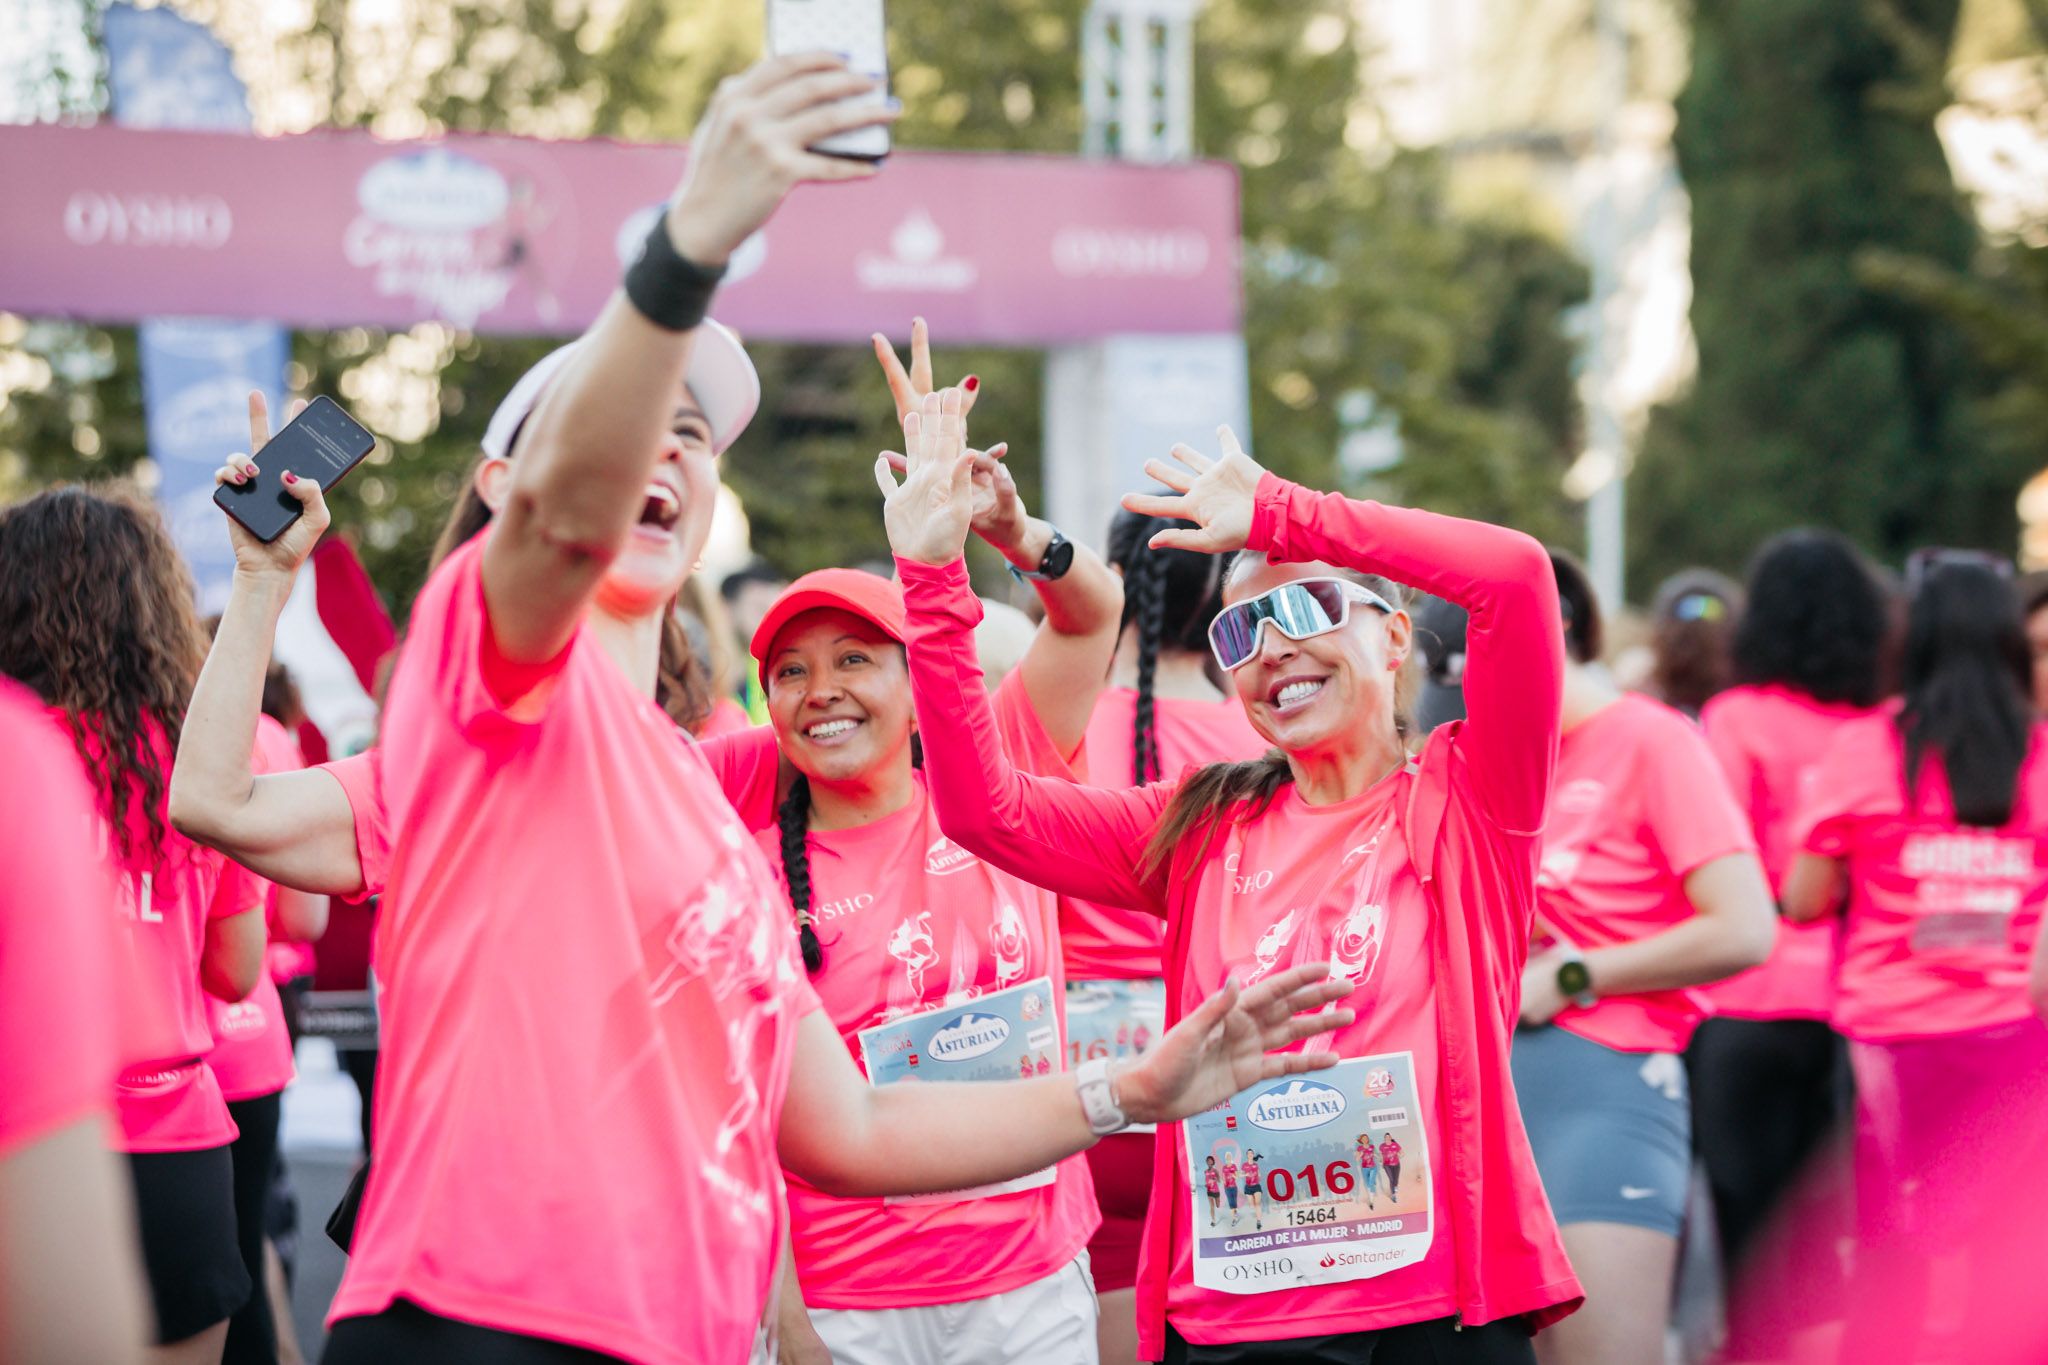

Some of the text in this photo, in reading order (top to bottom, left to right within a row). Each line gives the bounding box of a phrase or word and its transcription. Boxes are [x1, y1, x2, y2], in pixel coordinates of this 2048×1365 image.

[64, 190, 233, 249] OYSHO
[805, 893, 874, 926] YSHO
[934, 1028, 1006, 1056] ASTURIANA
[1368, 1070, 1390, 1088] 20
[1255, 1100, 1341, 1122] ASTURIANA
[1266, 1160, 1355, 1202] 016
[1286, 1206, 1337, 1226] 15464
[1224, 1236, 1273, 1252] CARRERA
[1275, 1232, 1290, 1245] DE
[1292, 1230, 1307, 1243] LA
[1309, 1226, 1348, 1241] MUJER
[1357, 1219, 1404, 1236] MADRID
[1223, 1257, 1293, 1281] OYSHO
[1337, 1248, 1406, 1267] Santander
